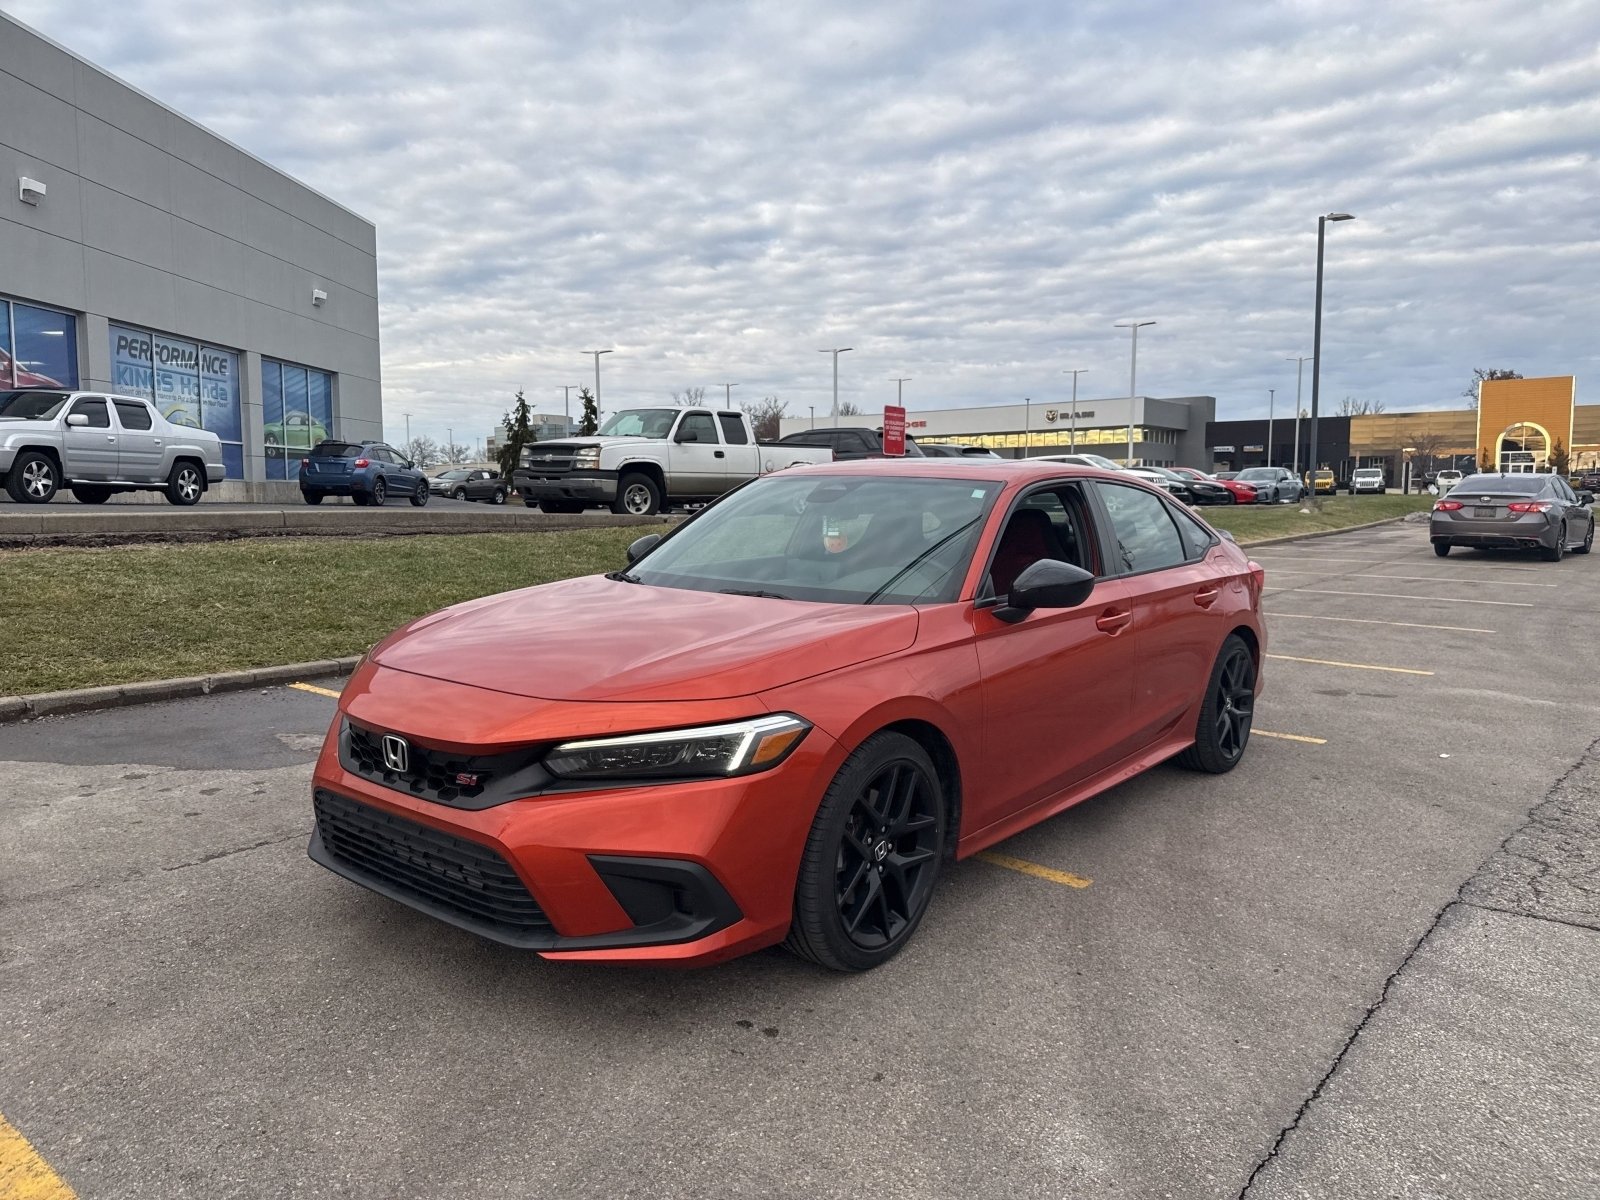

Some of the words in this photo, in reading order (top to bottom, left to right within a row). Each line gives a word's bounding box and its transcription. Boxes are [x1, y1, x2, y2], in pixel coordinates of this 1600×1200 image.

[116, 335, 228, 376] PERFORMANCE
[116, 363, 174, 392] KINGS
[180, 376, 228, 401] Honda
[1059, 411, 1095, 419] RAM
